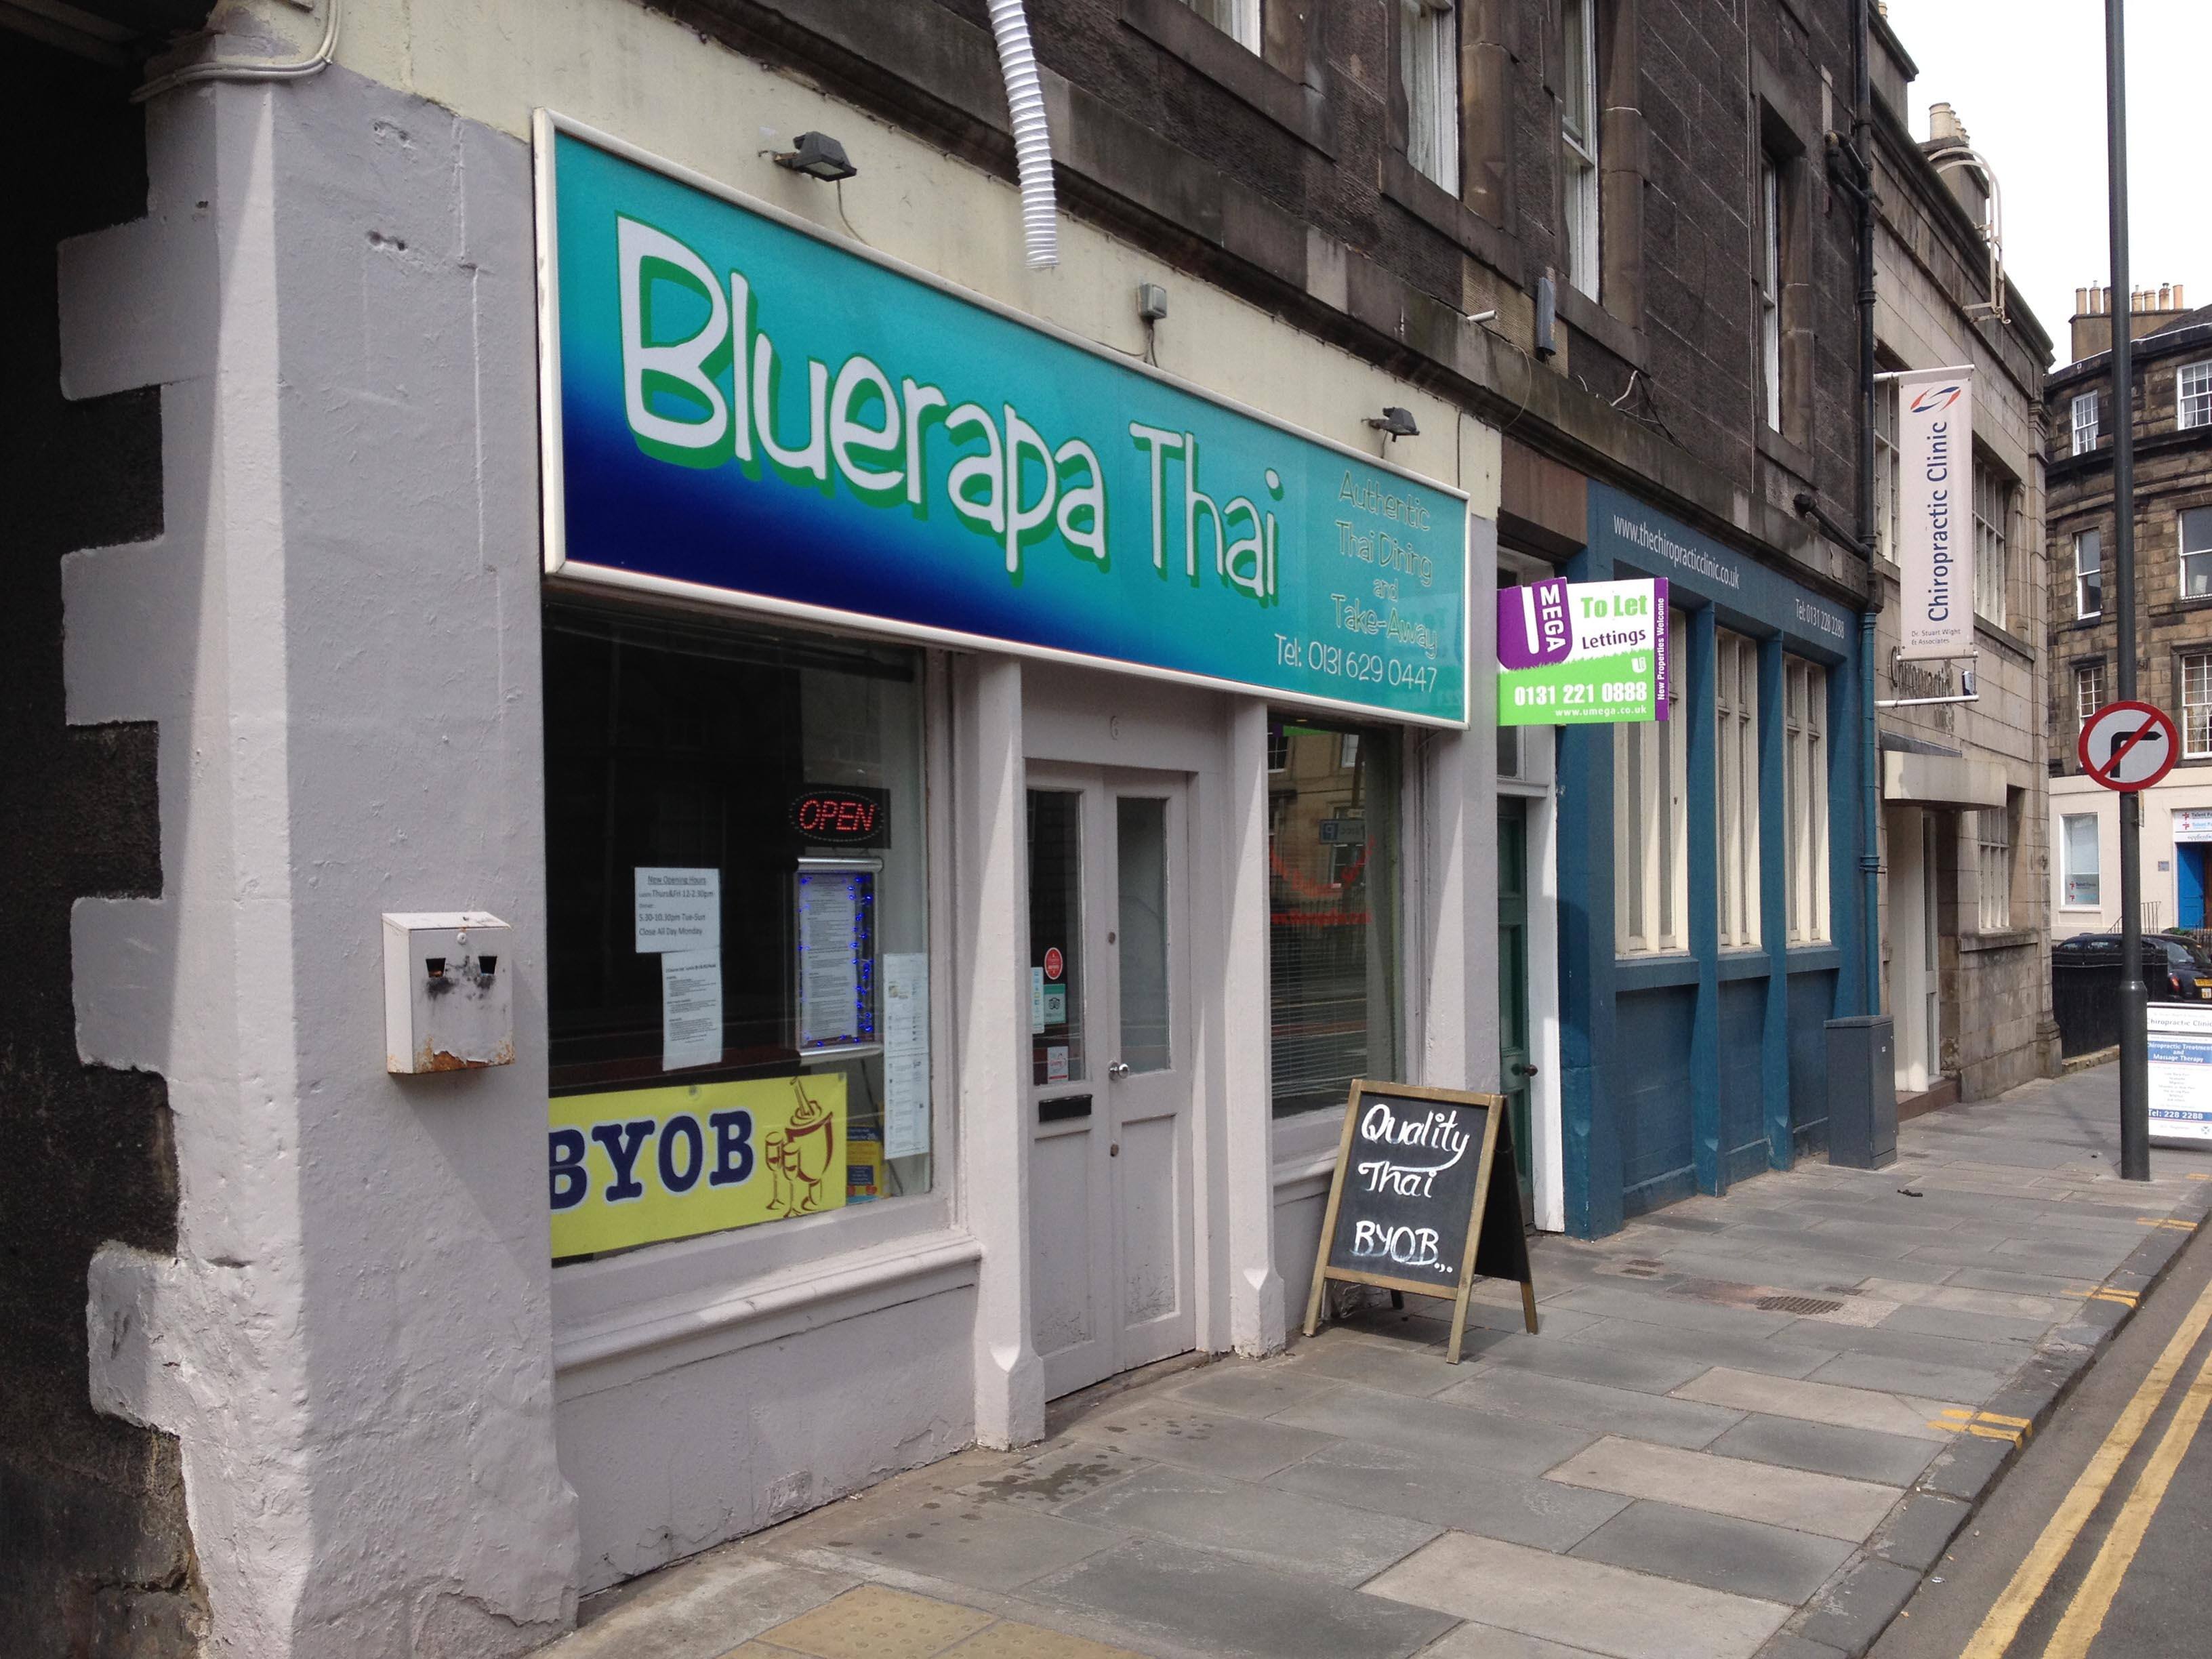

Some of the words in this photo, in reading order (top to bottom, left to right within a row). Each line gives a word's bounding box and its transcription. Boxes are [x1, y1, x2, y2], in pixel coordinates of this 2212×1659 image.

[616, 213, 1109, 581] Bluerapa
[1128, 420, 1282, 605] Thai
[1927, 421, 1947, 482] Clinic
[1339, 470, 1431, 531] Authentic
[1335, 519, 1374, 563] Thai
[1378, 531, 1432, 587] Dining
[1613, 514, 1740, 590] www.thechiropracticclinic.co.uk
[1927, 489, 1953, 622] Chiropractic
[1373, 578, 1399, 602] and
[1580, 596, 1608, 619] To
[1614, 594, 1648, 617] Let
[1330, 593, 1438, 659] Take-Away
[1539, 584, 1567, 653] MEGA
[1657, 598, 1665, 636] Welcome
[1795, 598, 1806, 622] Tel:
[1806, 604, 1820, 628] 0131
[1820, 611, 1831, 633] 228
[1831, 615, 1845, 639] 2288
[1582, 629, 1646, 650] Lettings
[1657, 638, 1666, 680] Properties
[1274, 633, 1302, 668] Tel:
[1309, 641, 1342, 676] 0131
[1346, 651, 1383, 682] 629
[1388, 659, 1437, 693] 0447
[1514, 684, 1557, 706] 0131
[1563, 683, 1595, 704] 221
[1601, 681, 1647, 703] 0888
[1555, 705, 1647, 717] www.umega.co.uk
[1658, 682, 1666, 701] New
[798, 799, 876, 832] OPEN
[663, 876, 689, 885] Opening
[638, 927, 656, 936] Close
[666, 927, 677, 936] Day
[678, 927, 703, 936] Monday
[2153, 1053, 2179, 1062] Massage
[2182, 1111, 2203, 1120] 2288
[1360, 1103, 1471, 1172] Quality
[548, 1108, 756, 1210] BYOB
[1357, 1160, 1437, 1199] Thai
